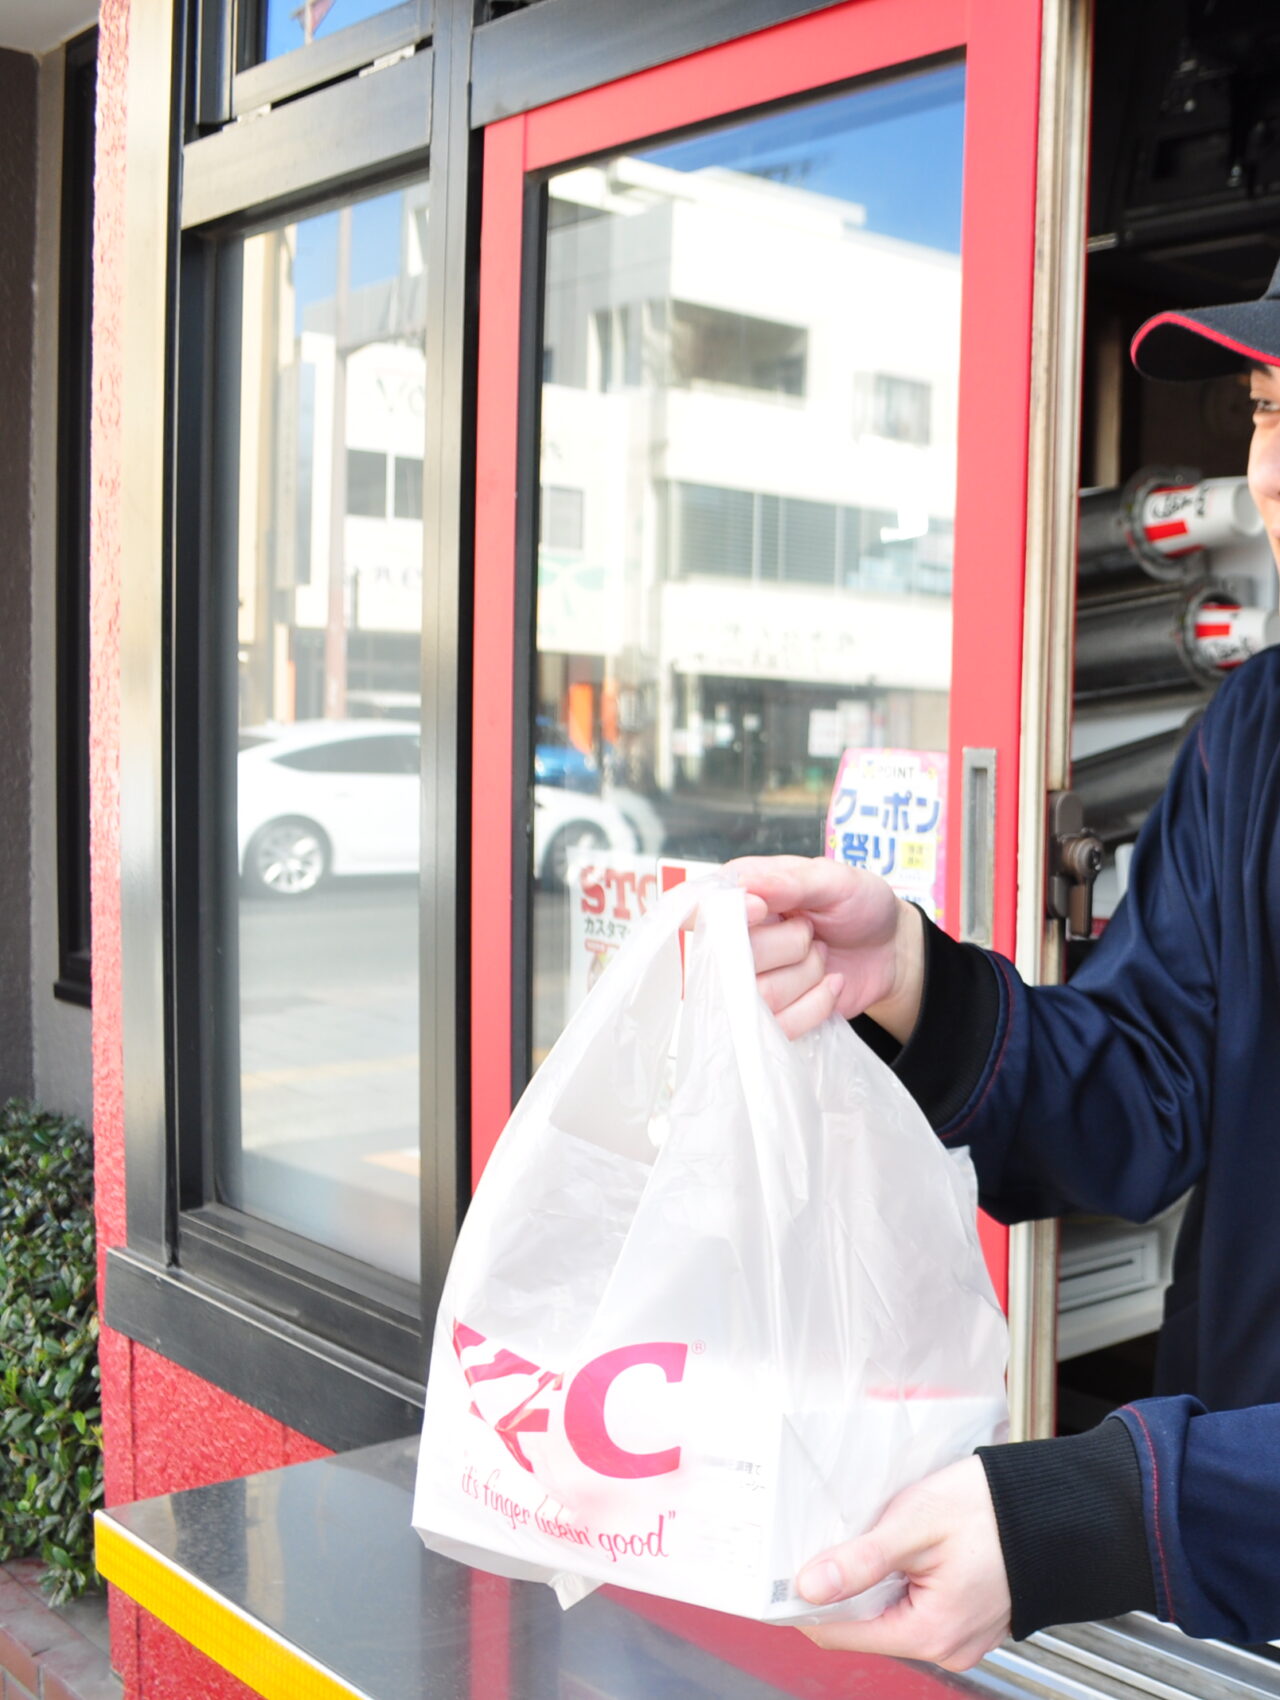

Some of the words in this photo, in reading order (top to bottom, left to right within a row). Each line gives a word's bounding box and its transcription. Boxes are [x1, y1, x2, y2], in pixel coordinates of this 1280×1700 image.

[833, 788, 941, 834] クーポン
[842, 832, 896, 876] 祭り
[584, 917, 630, 939] カスタマ
[462, 1465, 479, 1500] it's
[483, 1468, 531, 1530] finger
[534, 1494, 594, 1548] lickin'
